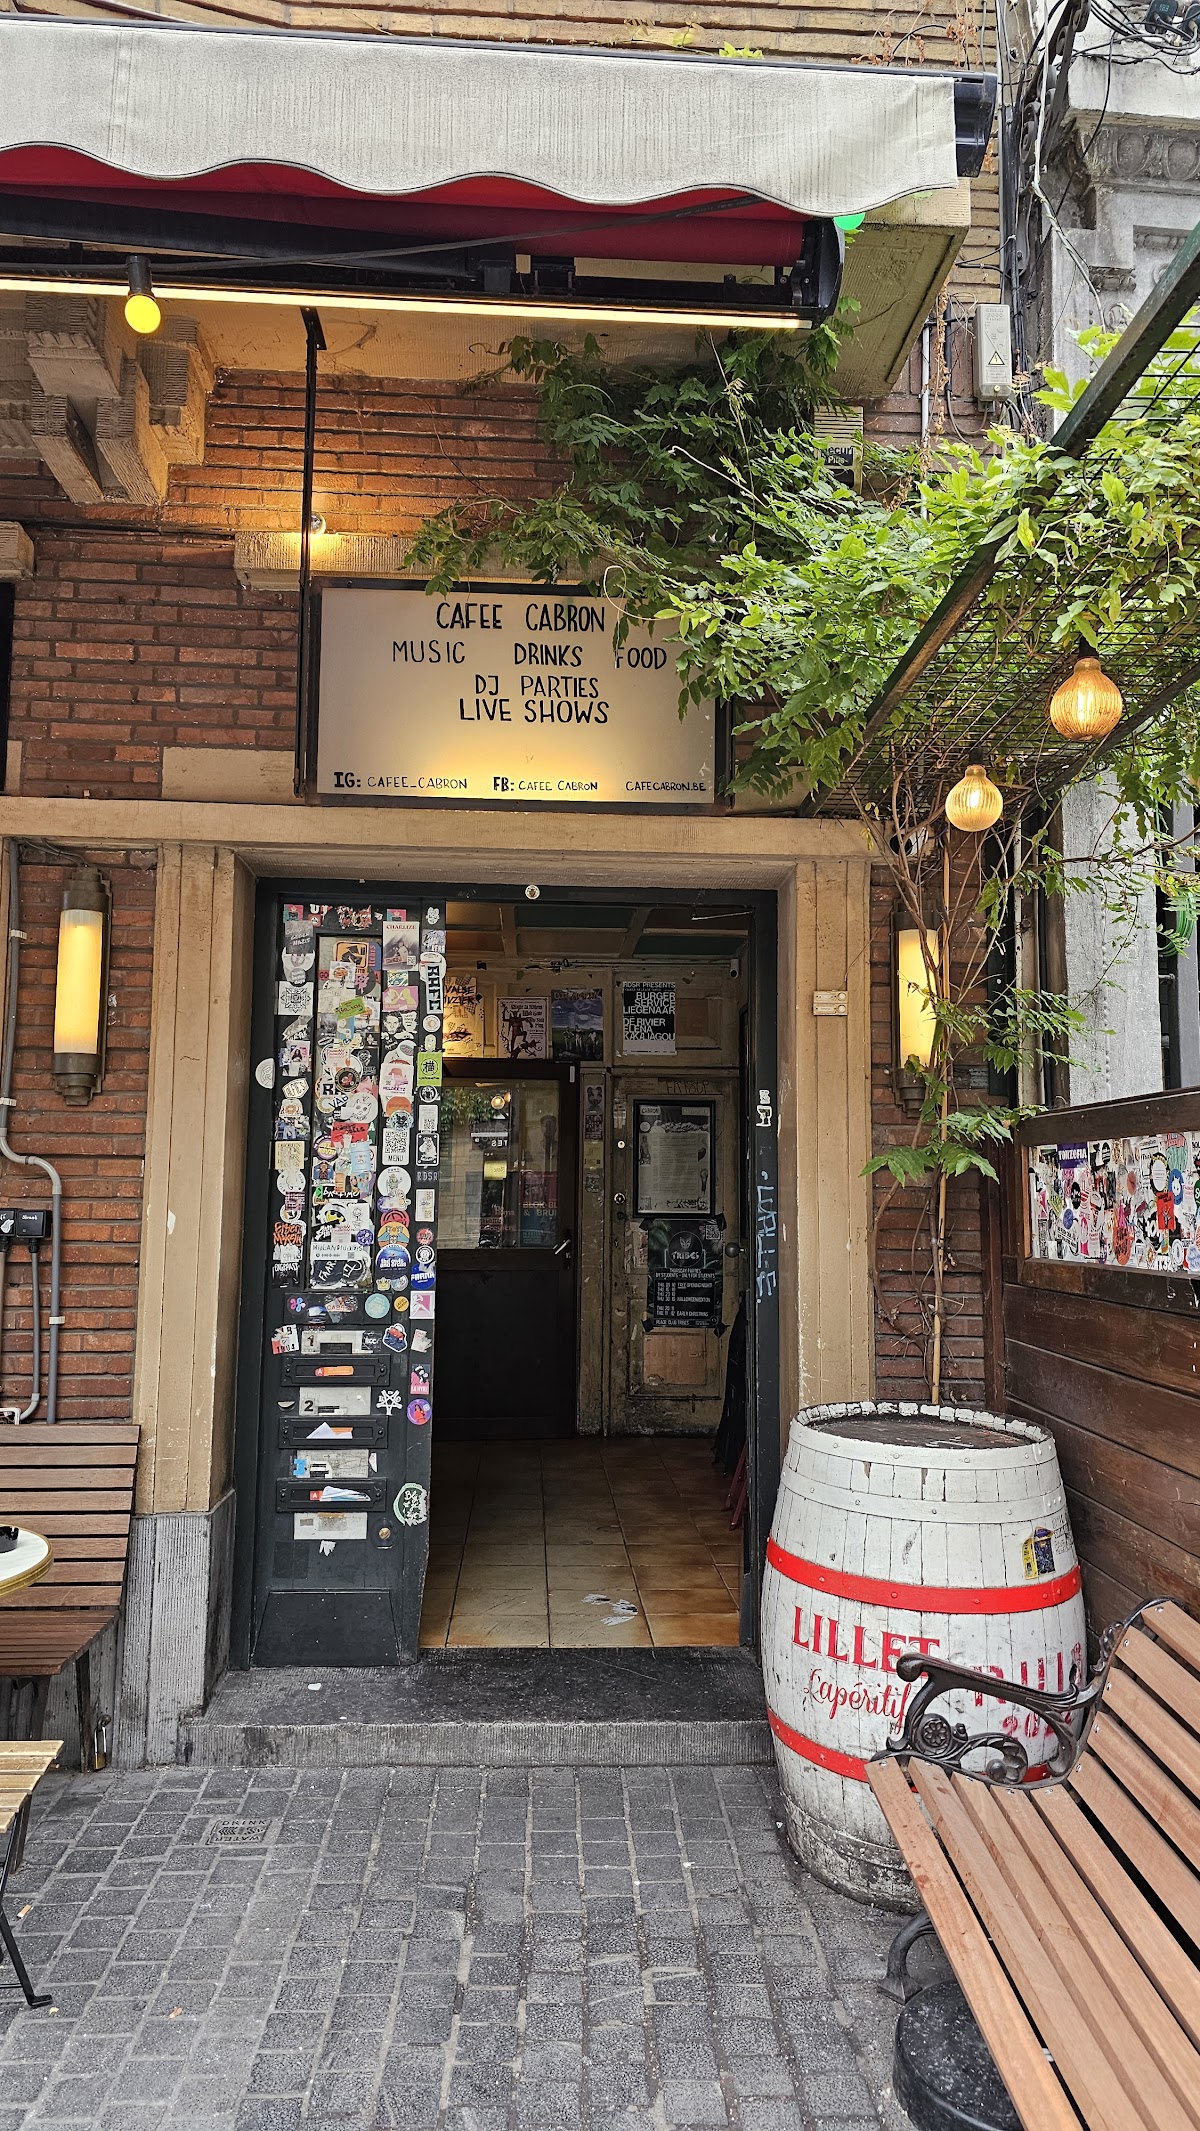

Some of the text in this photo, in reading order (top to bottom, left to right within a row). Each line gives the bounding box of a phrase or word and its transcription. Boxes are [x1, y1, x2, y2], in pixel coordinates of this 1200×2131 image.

[436, 602, 605, 633] CAFEE CABRON
[392, 639, 667, 670] MUSIC DRINKS FOOD
[475, 674, 599, 699] DJ PARTIES
[459, 698, 610, 725] LIVE SHOWS
[333, 771, 362, 789] IG:
[493, 776, 515, 792] FB:
[518, 780, 553, 792] CAFEE
[557, 780, 599, 792] CABRON
[625, 780, 707, 793] CAFECABRON.BE
[634, 999, 676, 1007] SERVICE
[636, 992, 676, 1000] BURGER
[623, 1006, 676, 1014] LIEGENAAR
[623, 1018, 666, 1027] DE RIVIER
[623, 1025, 653, 1033] ELENA
[304, 1400, 314, 1412] 2
[792, 1606, 940, 1678] LILLET
